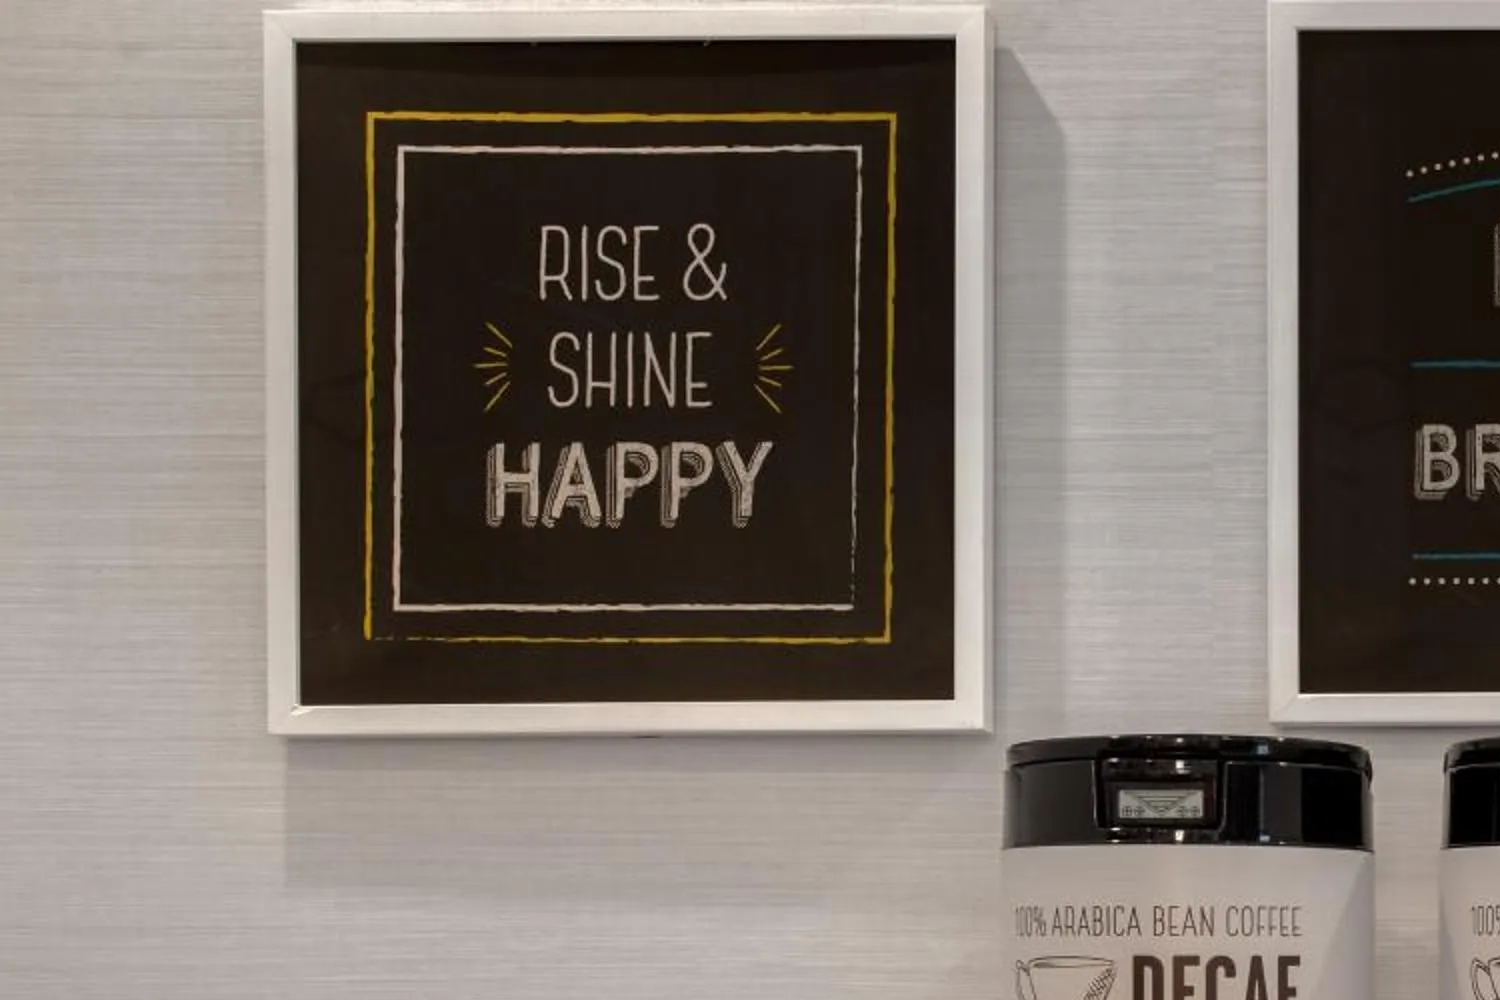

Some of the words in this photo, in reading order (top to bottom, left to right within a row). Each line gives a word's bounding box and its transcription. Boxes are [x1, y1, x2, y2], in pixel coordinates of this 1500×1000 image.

[538, 224, 660, 302] RISE
[682, 222, 727, 302] &
[547, 331, 712, 408] SHINE
[485, 441, 773, 529] HAPPY
[1014, 906, 1047, 938] 100%
[1051, 905, 1142, 938] ARABICA
[1152, 905, 1215, 938] BEAN
[1225, 905, 1303, 938] COFFEE
